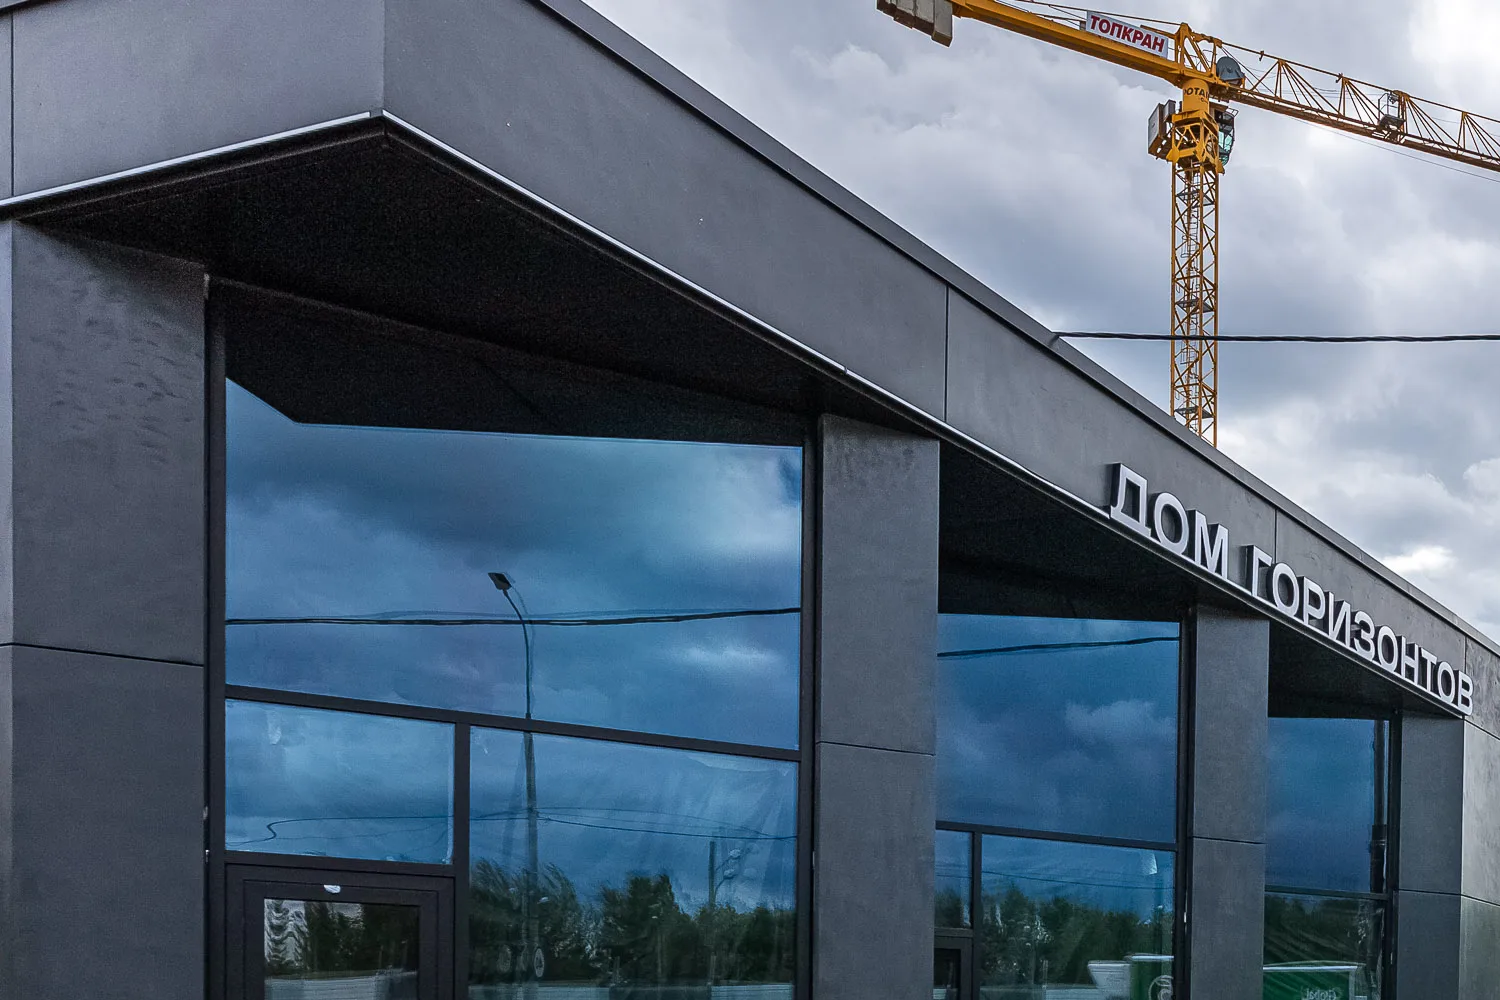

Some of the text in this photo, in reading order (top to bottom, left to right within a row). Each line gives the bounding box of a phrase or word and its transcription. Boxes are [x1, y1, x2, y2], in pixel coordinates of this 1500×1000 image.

[1091, 15, 1165, 53] ТОПКРАН
[1110, 463, 1474, 716] ДОМ ГОРИЗОНТОВ
